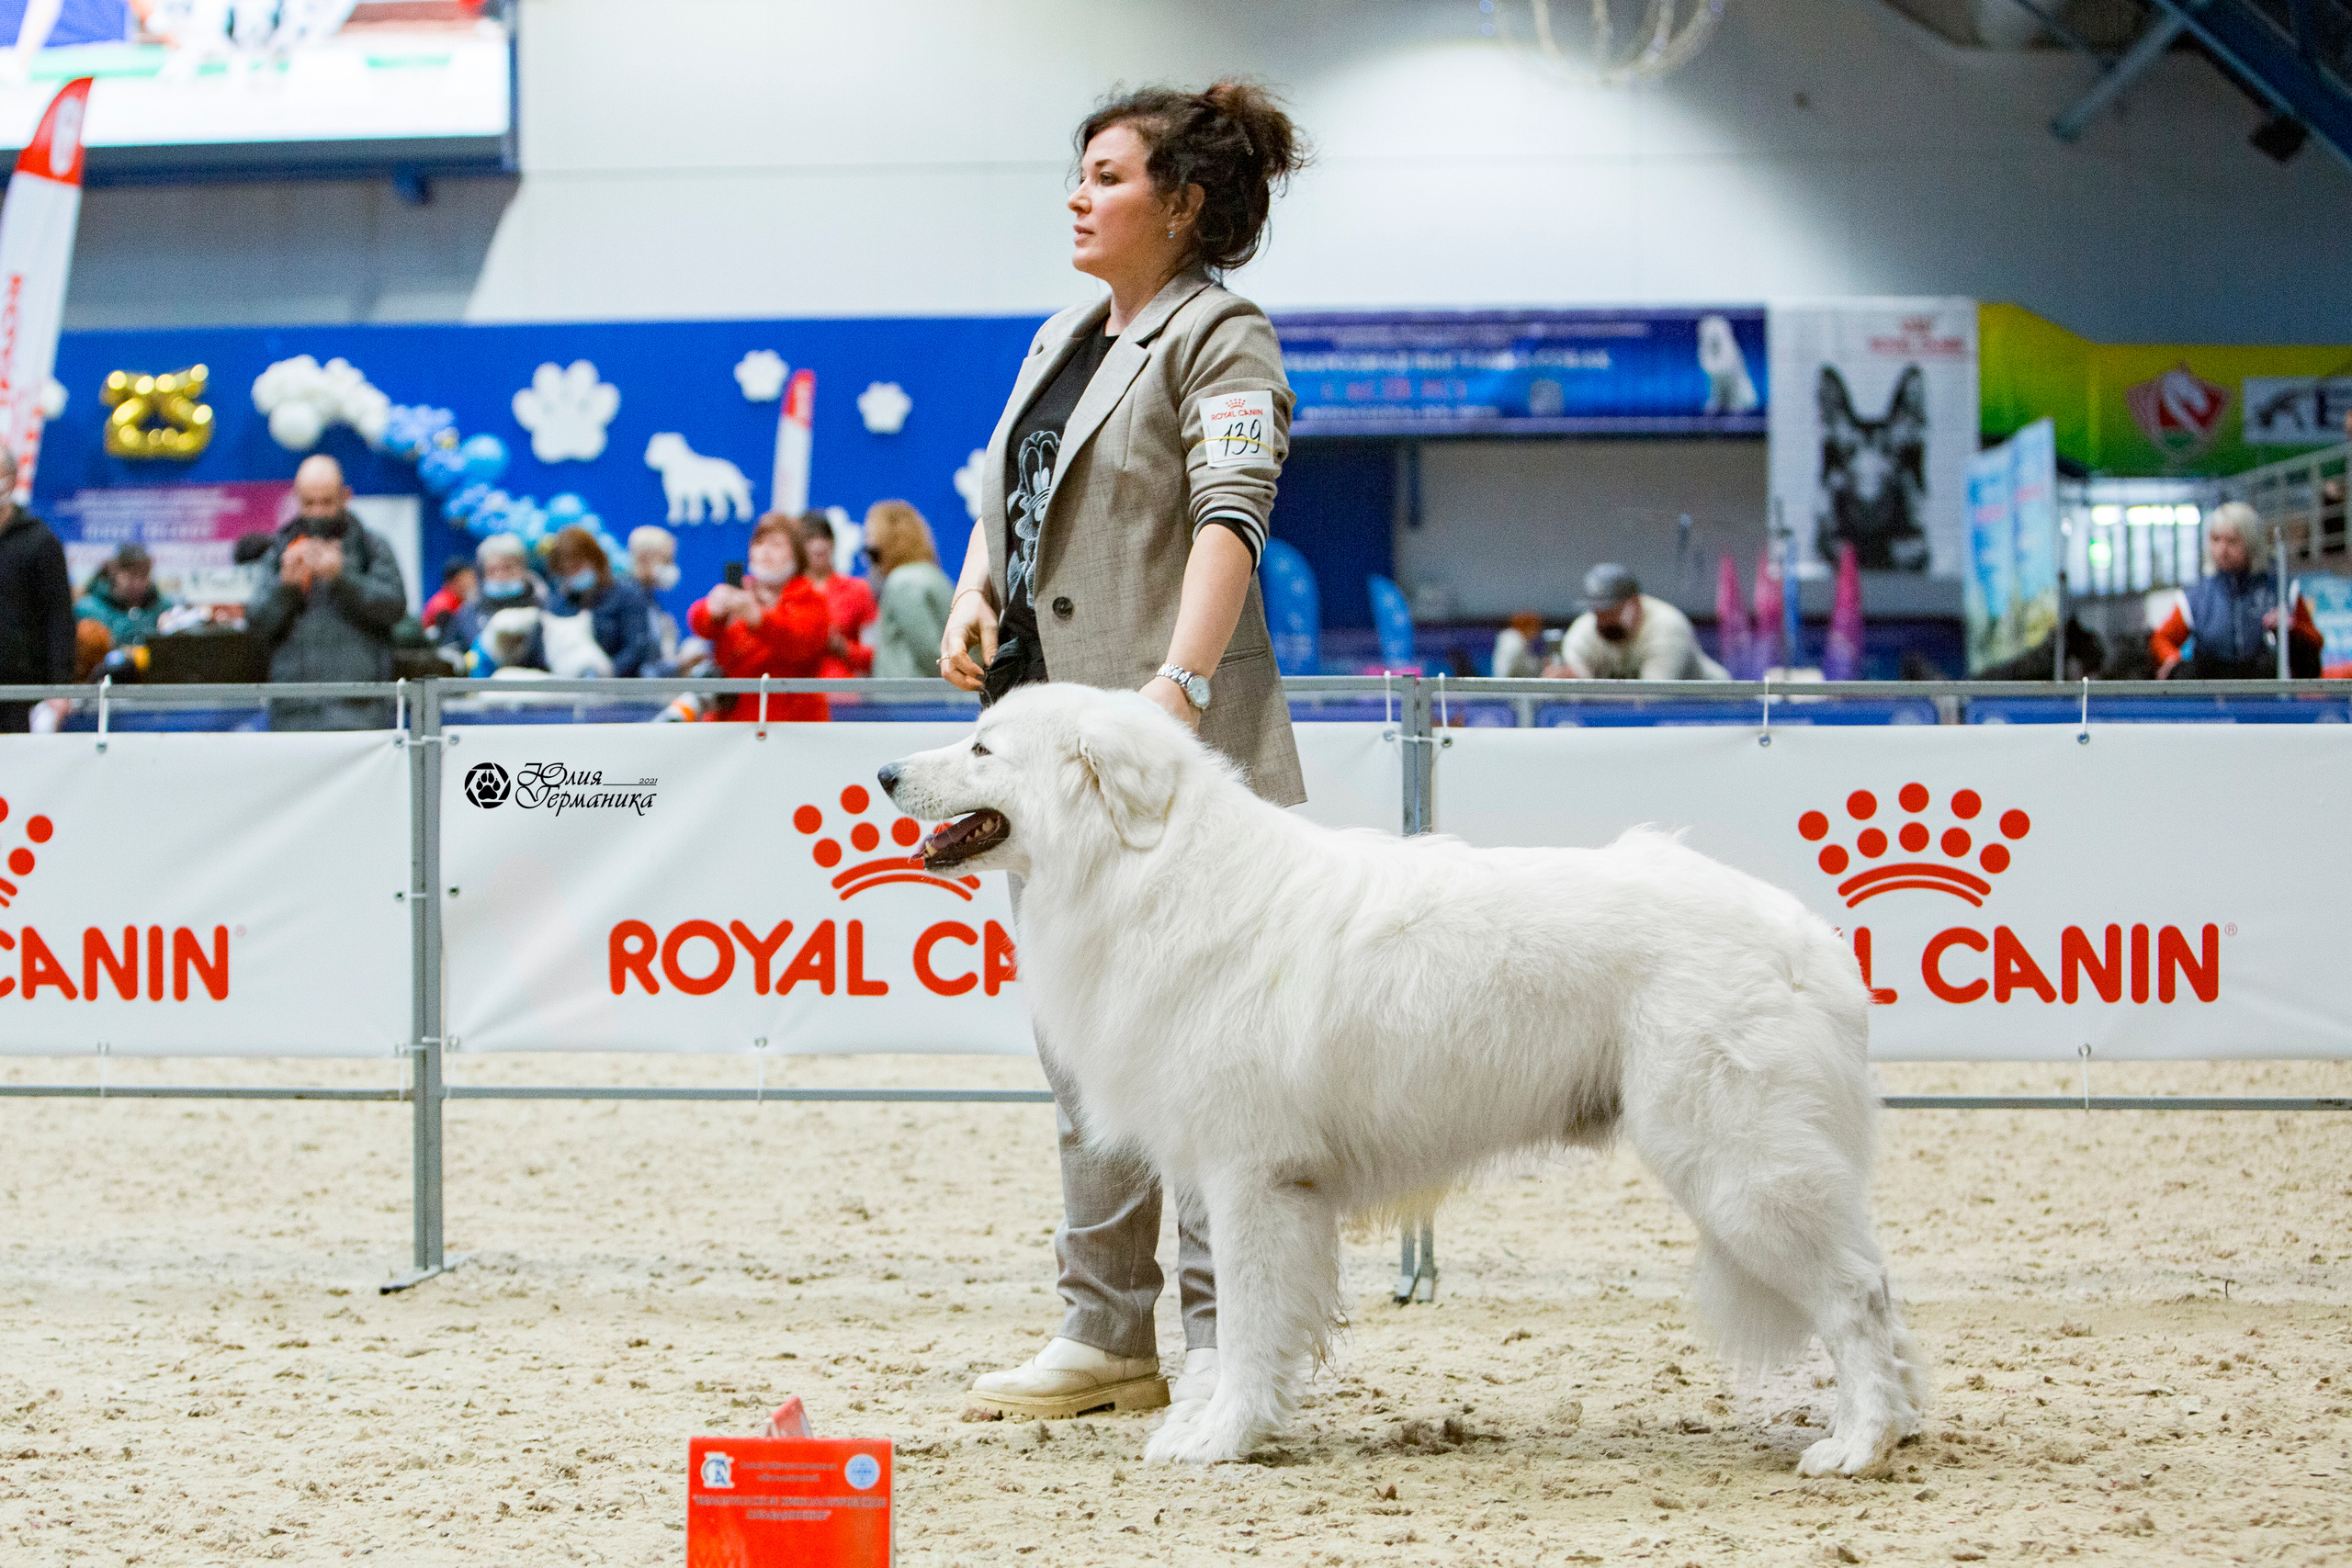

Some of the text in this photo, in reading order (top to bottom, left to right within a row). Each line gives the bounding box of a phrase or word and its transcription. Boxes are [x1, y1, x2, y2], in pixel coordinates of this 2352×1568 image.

[1211, 409, 1263, 421] ROYAL CANIN
[1220, 419, 1261, 457] 139
[0, 924, 229, 1001] ANIN
[608, 919, 889, 997] ROYAL
[1921, 922, 2220, 1004] CANIN
